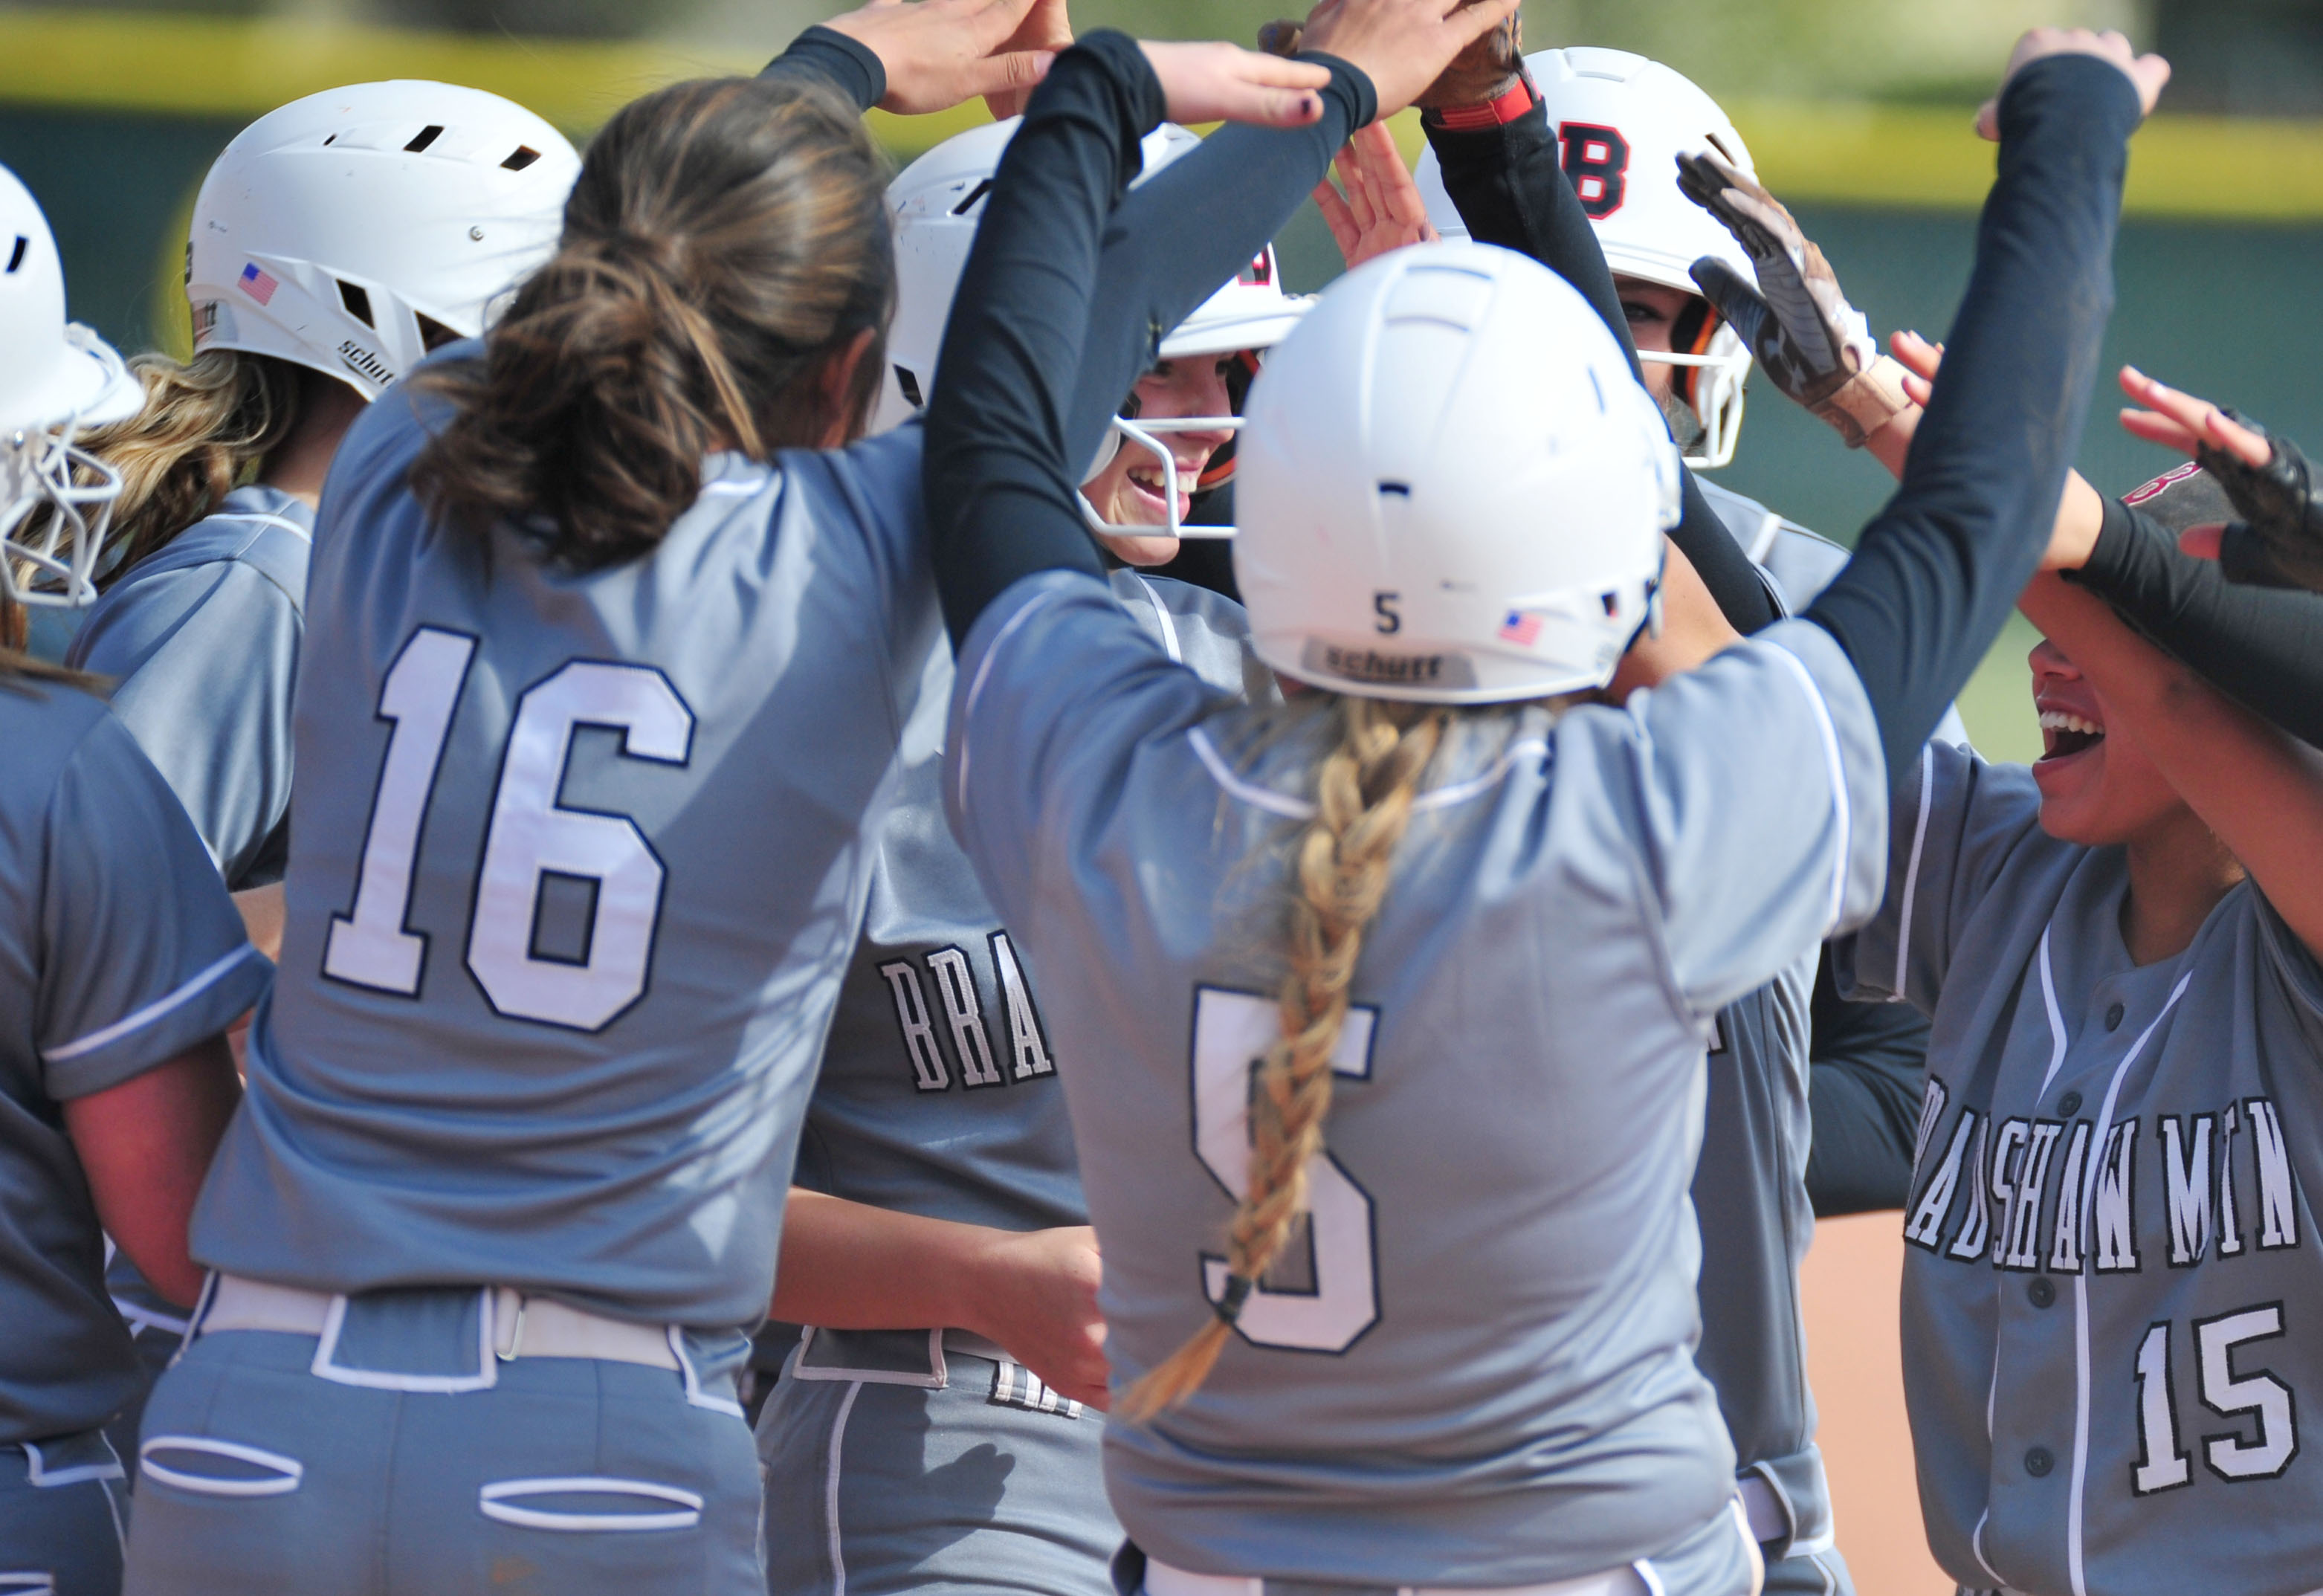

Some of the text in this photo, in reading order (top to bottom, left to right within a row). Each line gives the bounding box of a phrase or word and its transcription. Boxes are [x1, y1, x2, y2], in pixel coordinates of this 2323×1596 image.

[1558, 121, 1630, 220] B
[1374, 592, 1400, 633] 5
[320, 623, 697, 1035] 16
[875, 928, 1057, 1092] BRA
[1189, 980, 1382, 1356] 5
[2130, 1299, 2300, 1496] 15
